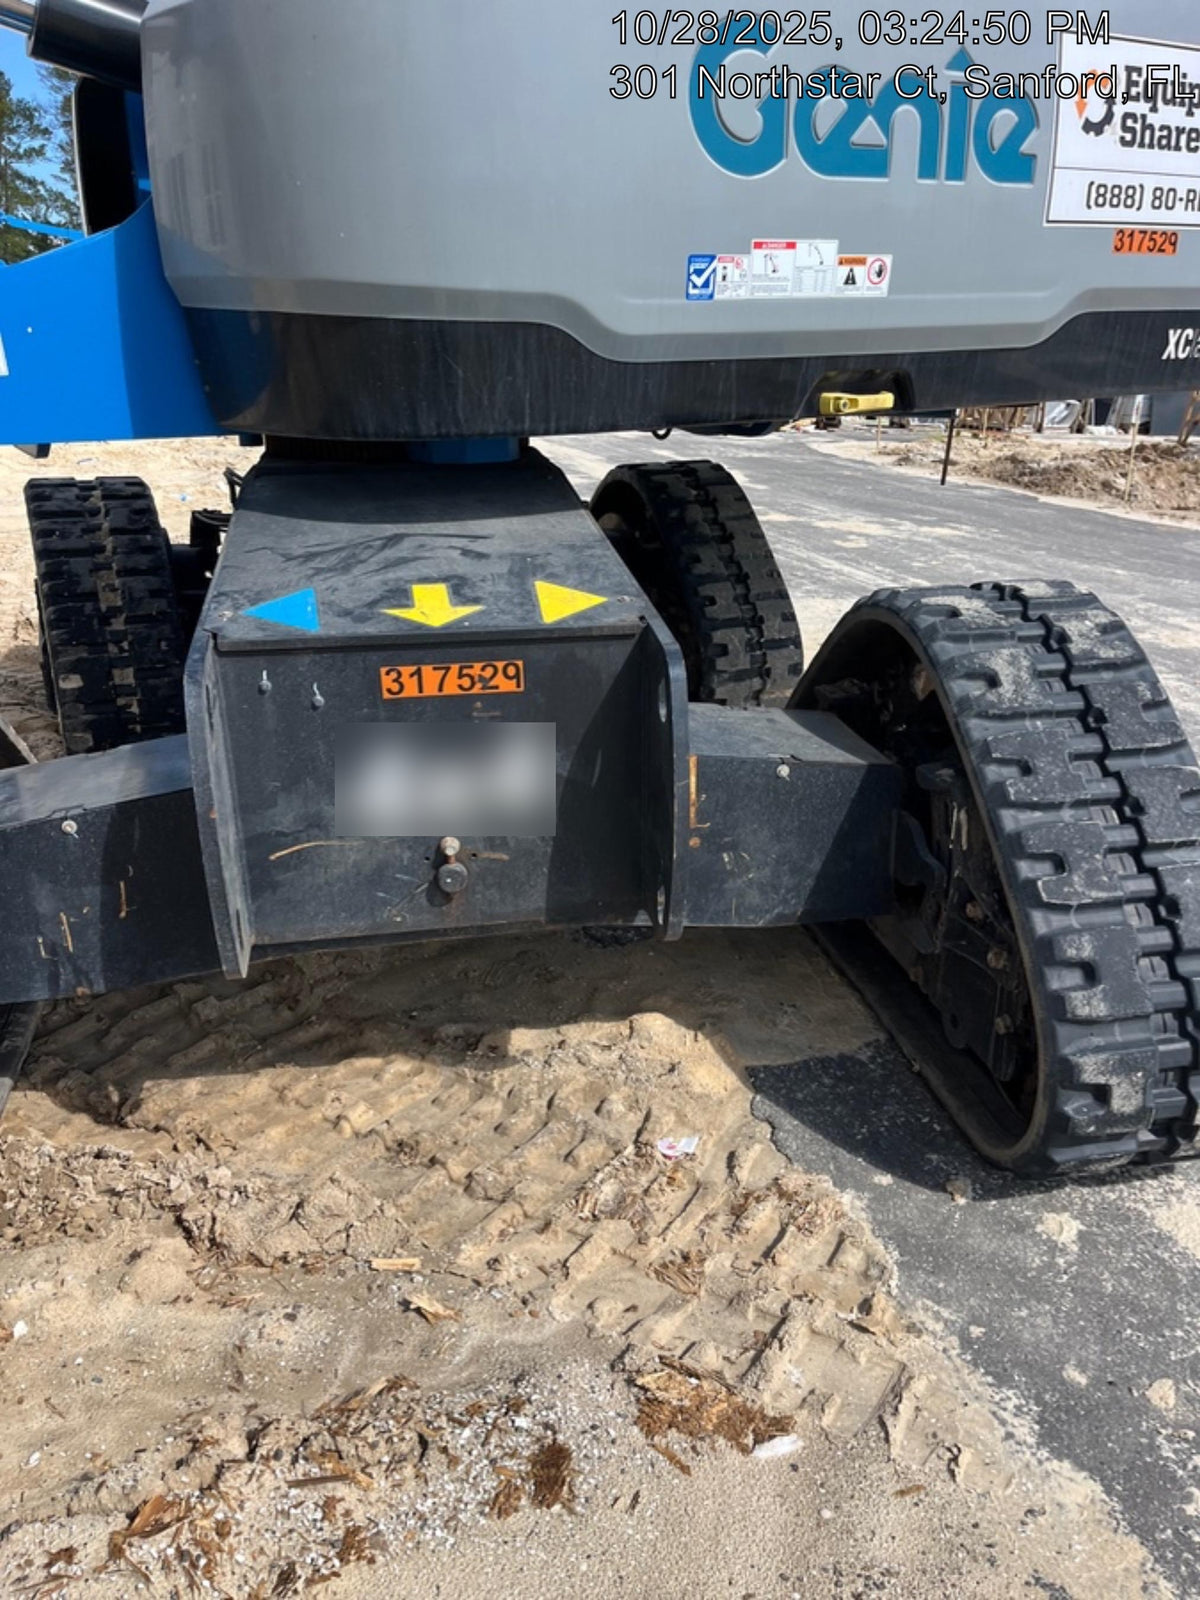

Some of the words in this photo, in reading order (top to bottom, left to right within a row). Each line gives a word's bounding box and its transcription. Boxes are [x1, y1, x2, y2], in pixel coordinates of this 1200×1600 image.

[688, 12, 1040, 188] Genie
[1119, 112, 1200, 154] Share
[1085, 181, 1144, 212] (888)
[1150, 186, 1200, 212] 80-R
[1114, 229, 1178, 254] 317529
[384, 662, 522, 696] 317529
